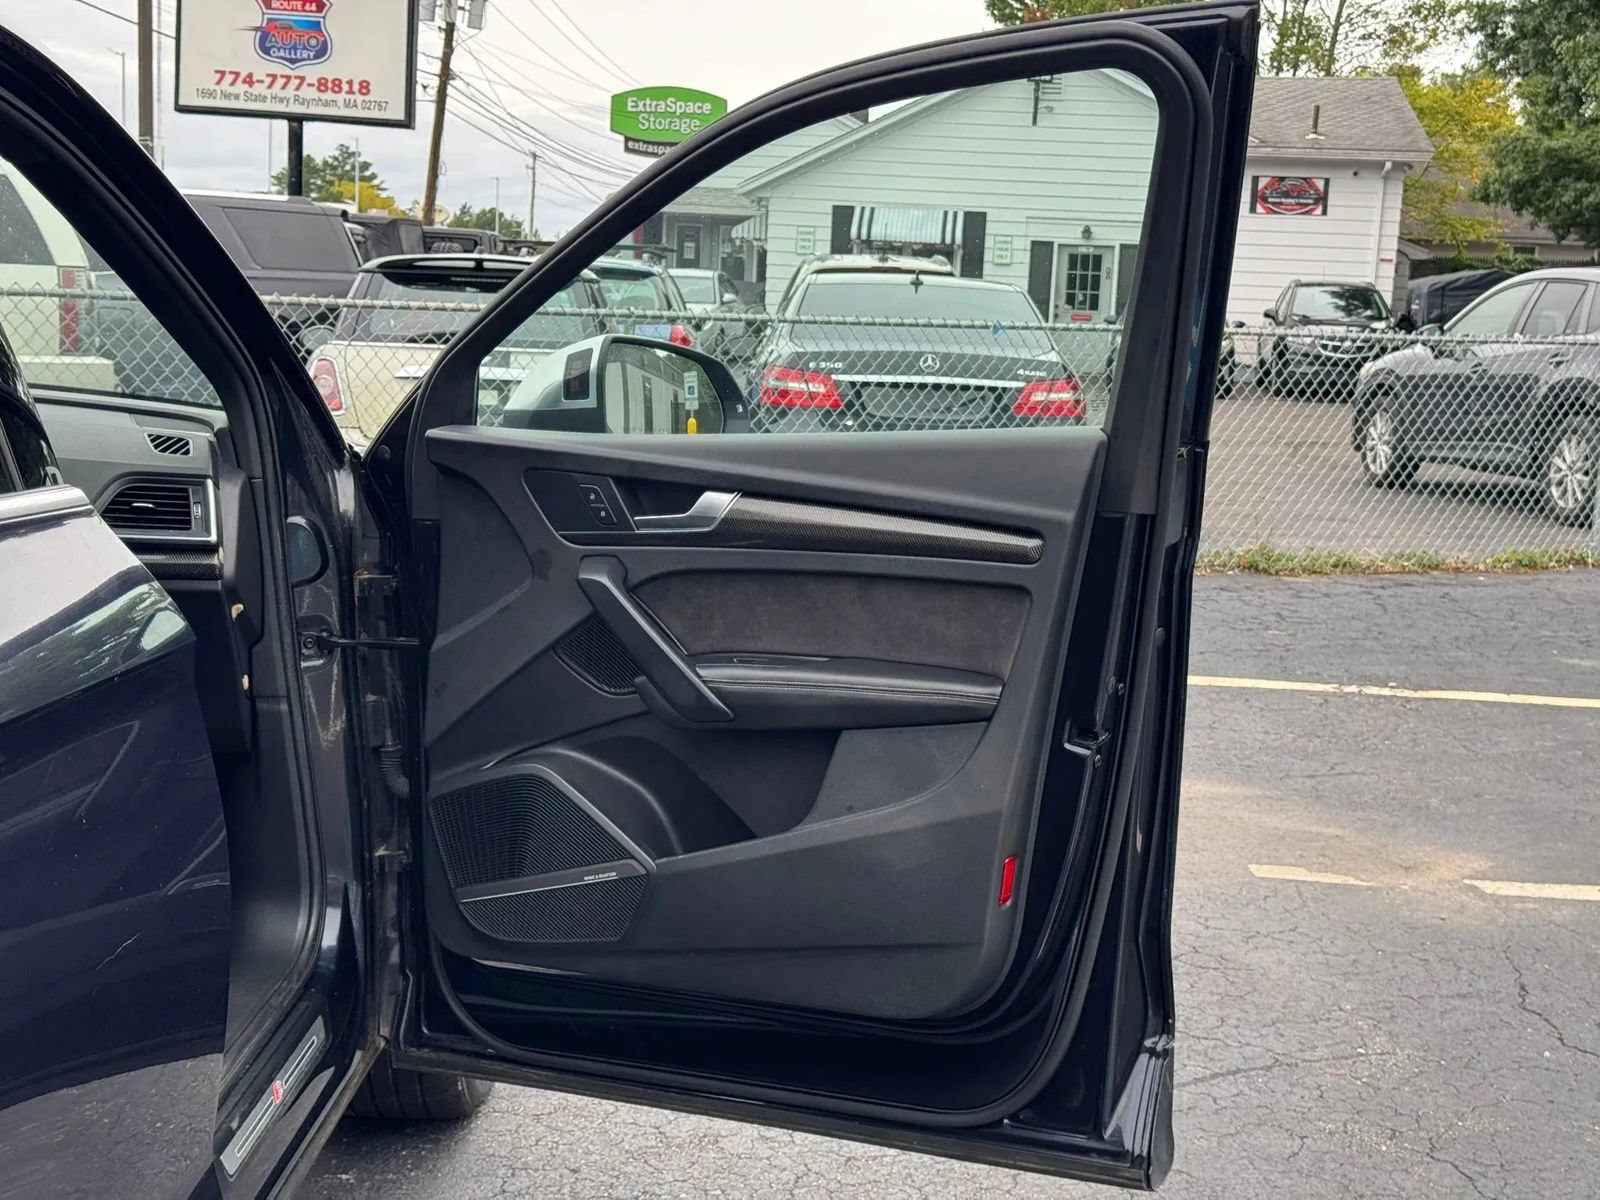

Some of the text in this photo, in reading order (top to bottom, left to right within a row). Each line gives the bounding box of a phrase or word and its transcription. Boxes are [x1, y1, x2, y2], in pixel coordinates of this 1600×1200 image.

[271, 0, 317, 11] ROUTE 44
[265, 31, 323, 50] AUTO
[269, 47, 316, 59] GALLERY
[214, 70, 371, 96] 774-777-8818
[219, 89, 241, 101] New
[243, 90, 268, 103] State
[270, 92, 290, 107] Hwy
[293, 94, 341, 110] Raynham,
[343, 97, 358, 109] MA
[360, 99, 389, 112] 02767
[626, 97, 712, 115] ExtraSpace
[638, 113, 701, 134] Storage
